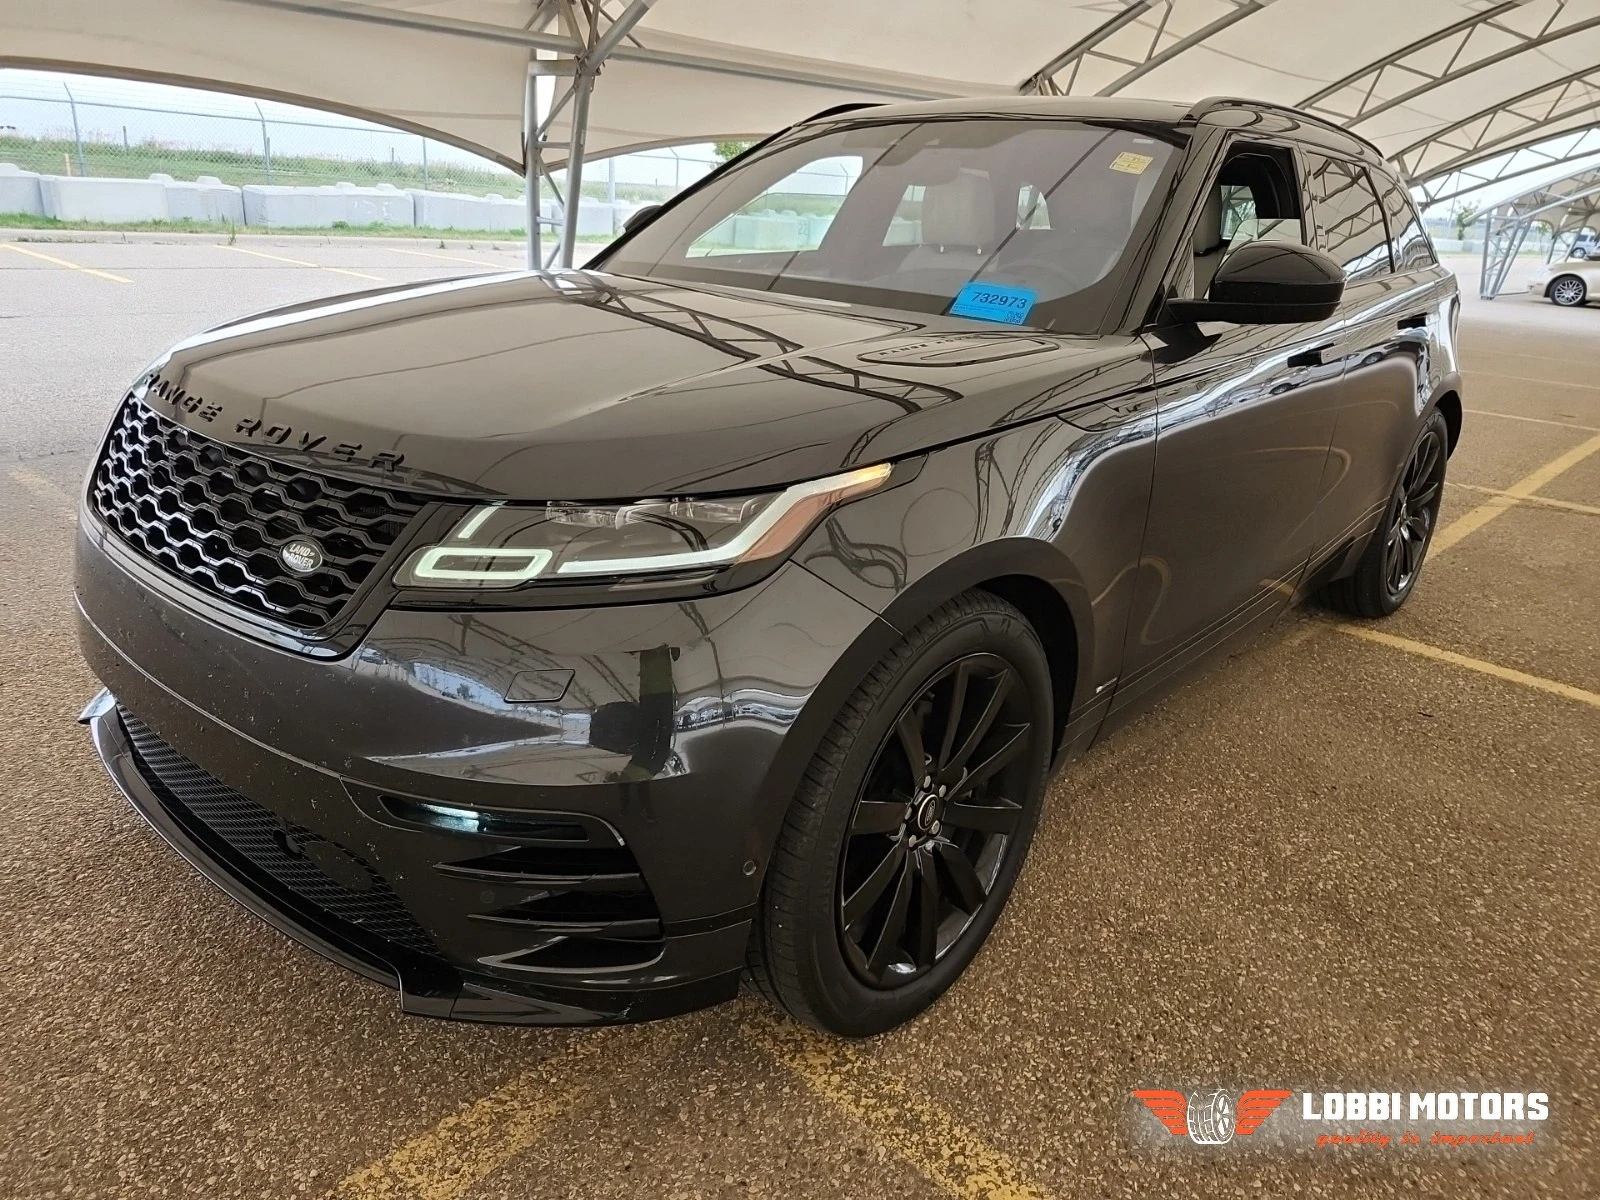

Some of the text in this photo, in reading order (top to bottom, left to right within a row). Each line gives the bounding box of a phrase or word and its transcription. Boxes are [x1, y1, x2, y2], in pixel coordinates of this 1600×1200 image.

[970, 291, 1027, 309] 732973
[234, 416, 405, 472] ROVER
[290, 552, 314, 569] ROVER
